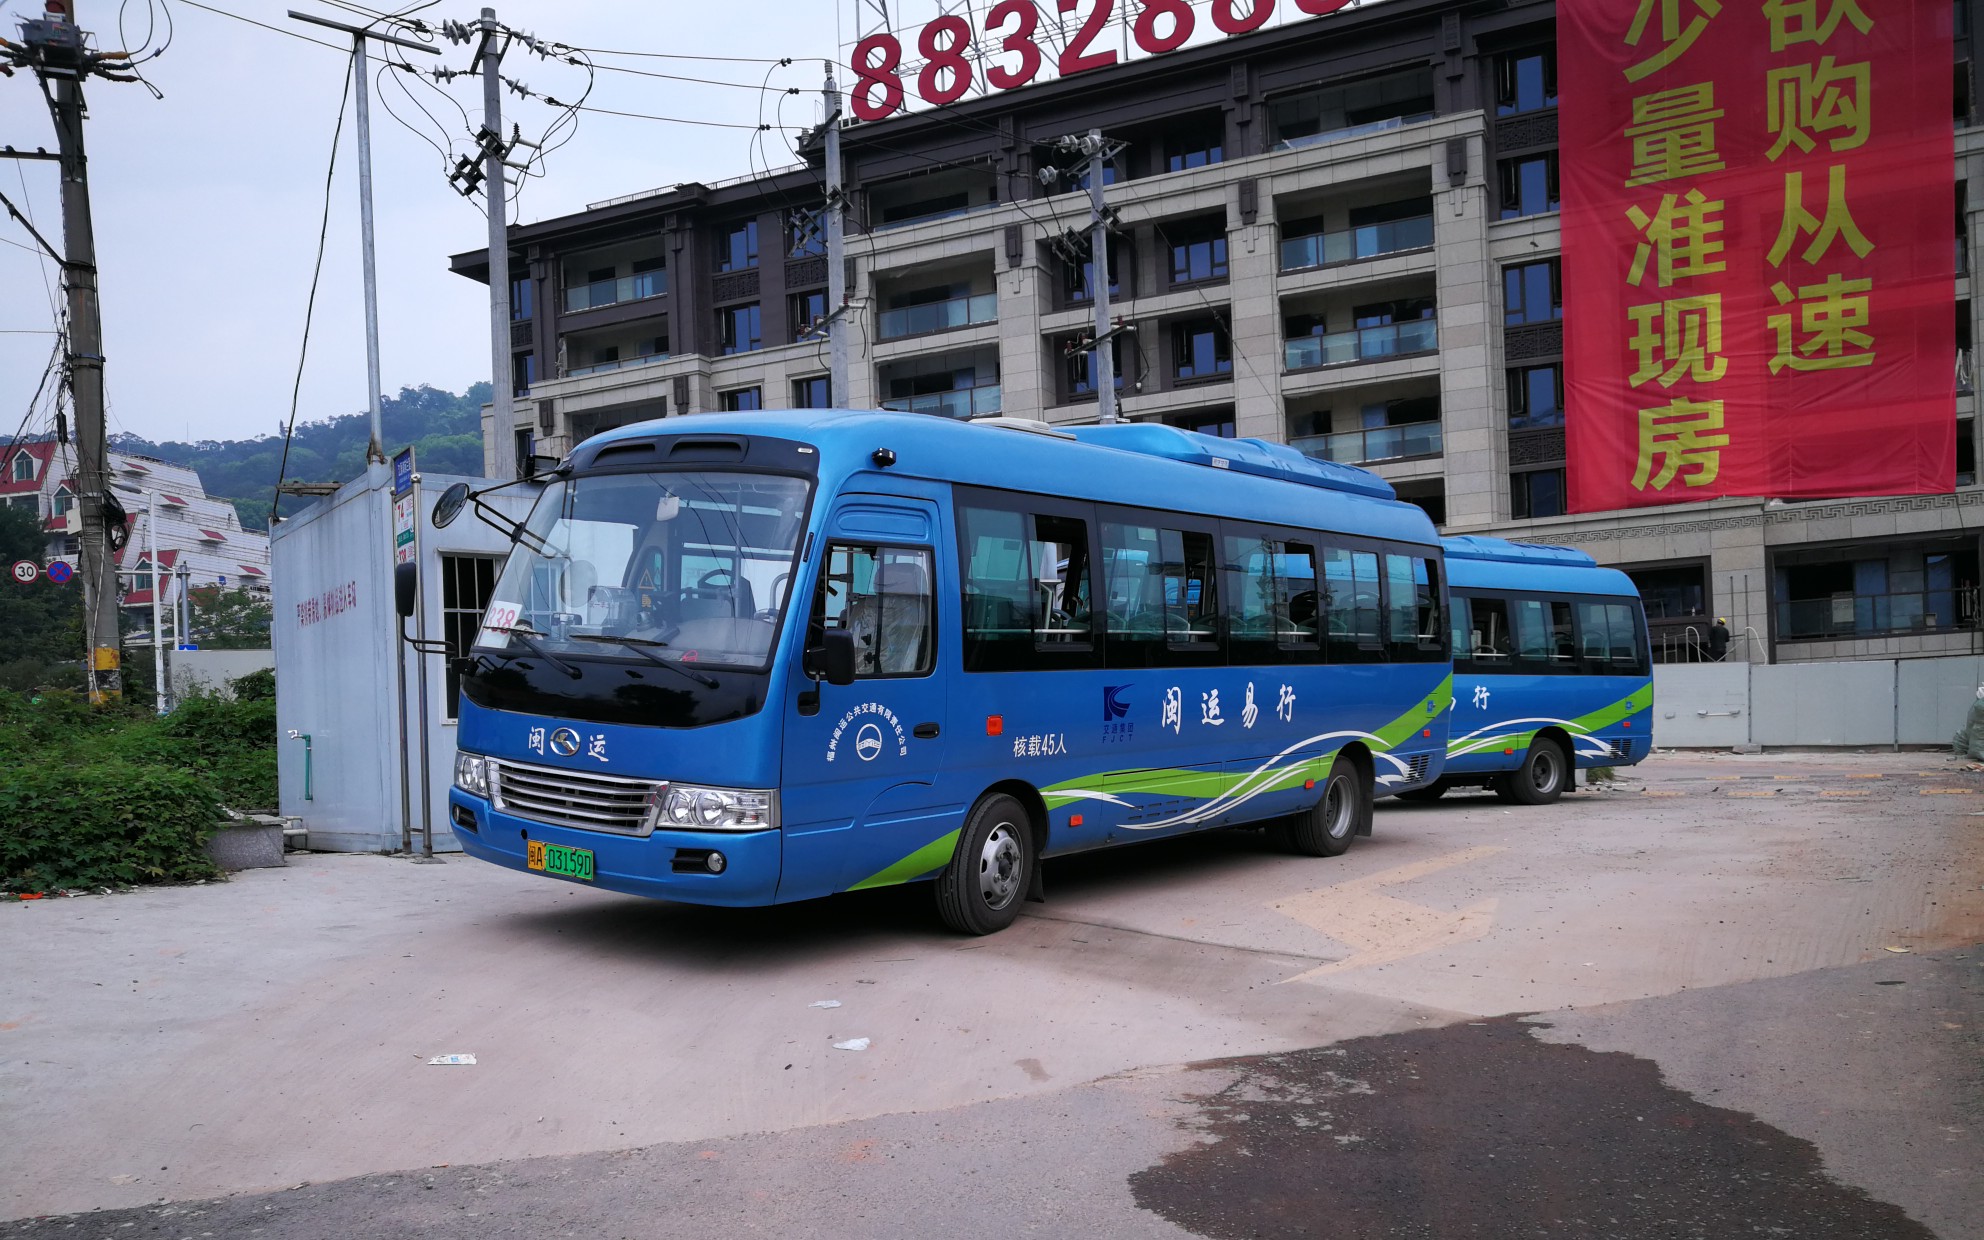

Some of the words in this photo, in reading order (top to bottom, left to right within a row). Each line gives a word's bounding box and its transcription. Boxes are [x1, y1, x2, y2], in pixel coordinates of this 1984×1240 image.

[851, 0, 1357, 121] 88328
[1623, 0, 1729, 491] 少量准现房
[18, 566, 34, 577] 30
[1103, 722, 1134, 734] 交通集团
[1161, 681, 1296, 735] 闽运易行
[528, 726, 545, 756] 闽
[588, 734, 609, 762] 运
[826, 702, 908, 762] 福州闽运公共交通有限责任公司
[1013, 733, 1067, 758] 核载45人
